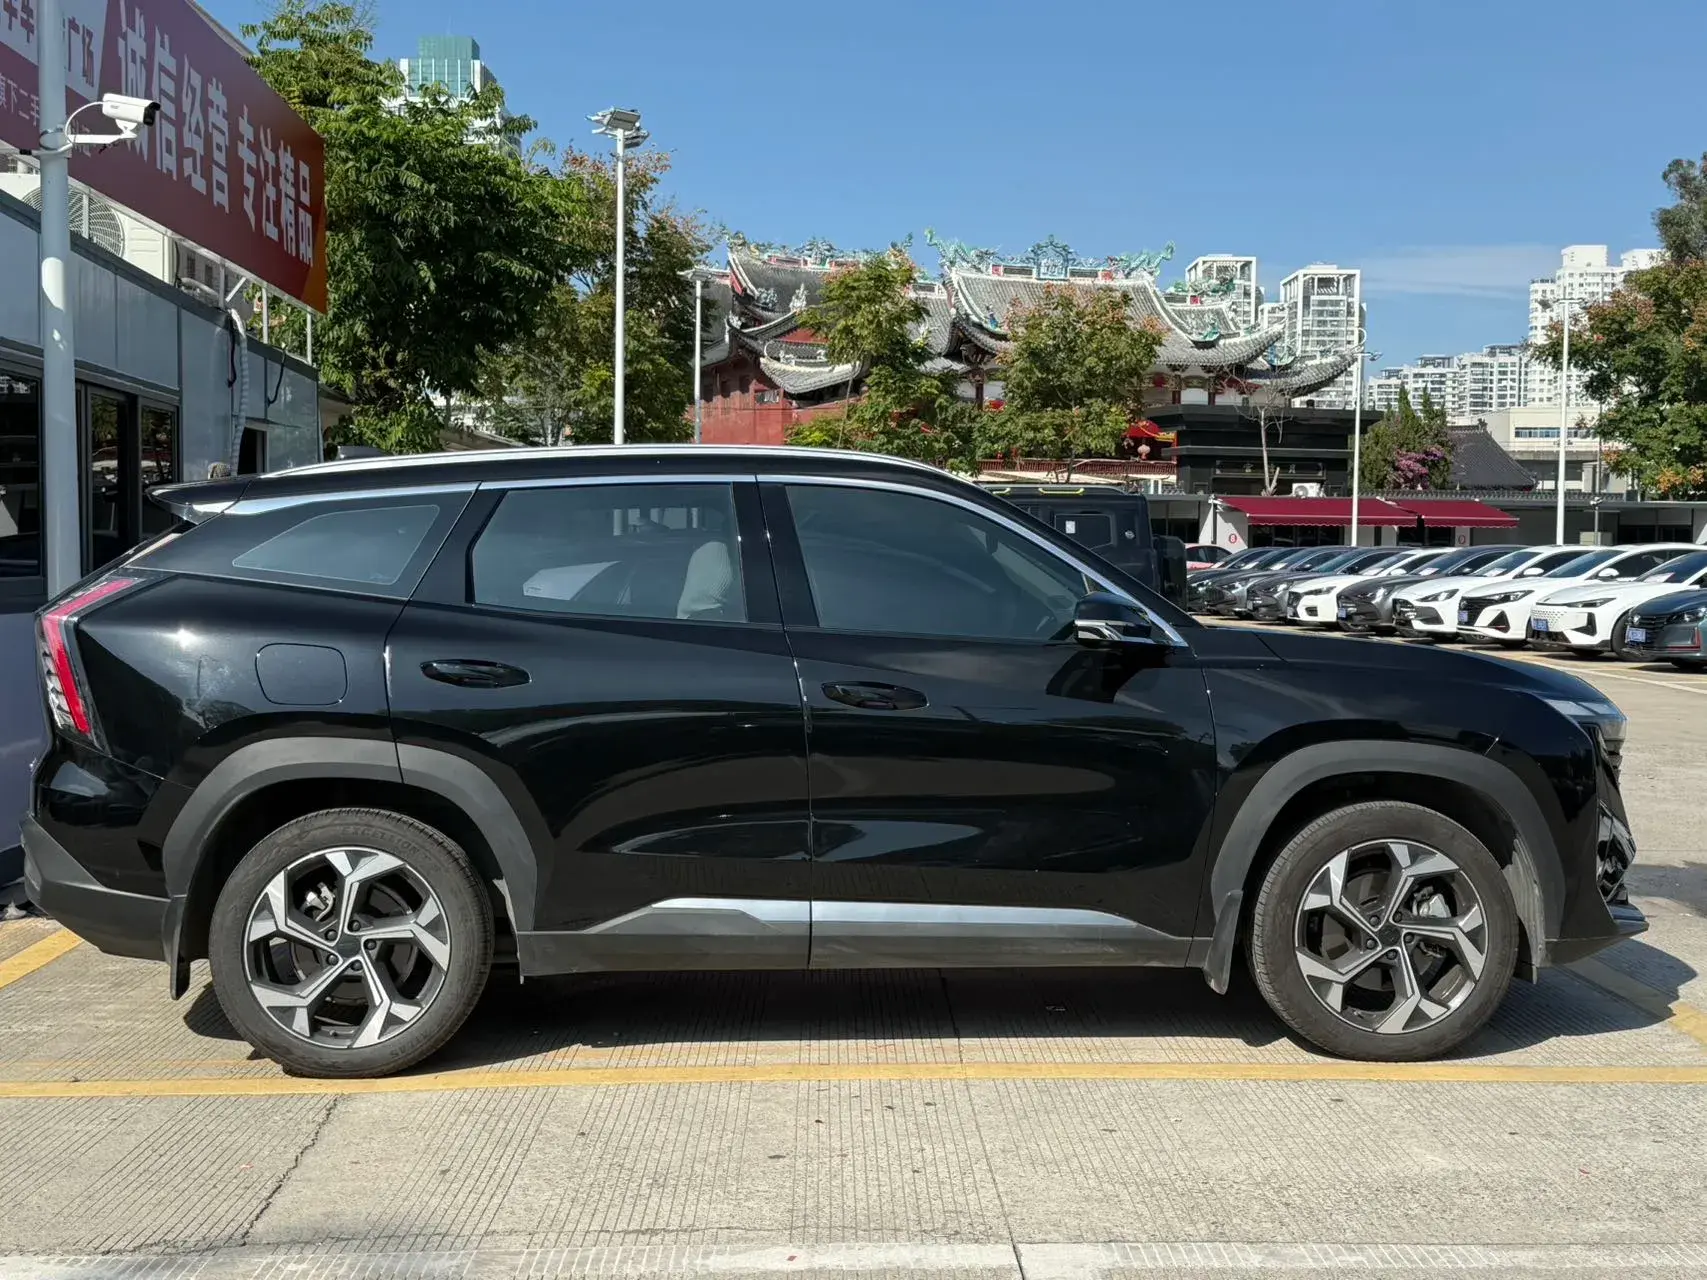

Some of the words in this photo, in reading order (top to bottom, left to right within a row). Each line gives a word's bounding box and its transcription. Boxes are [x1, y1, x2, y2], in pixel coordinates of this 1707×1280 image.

[118, 0, 229, 214] 诚信经营
[237, 104, 313, 267] 专注精品
